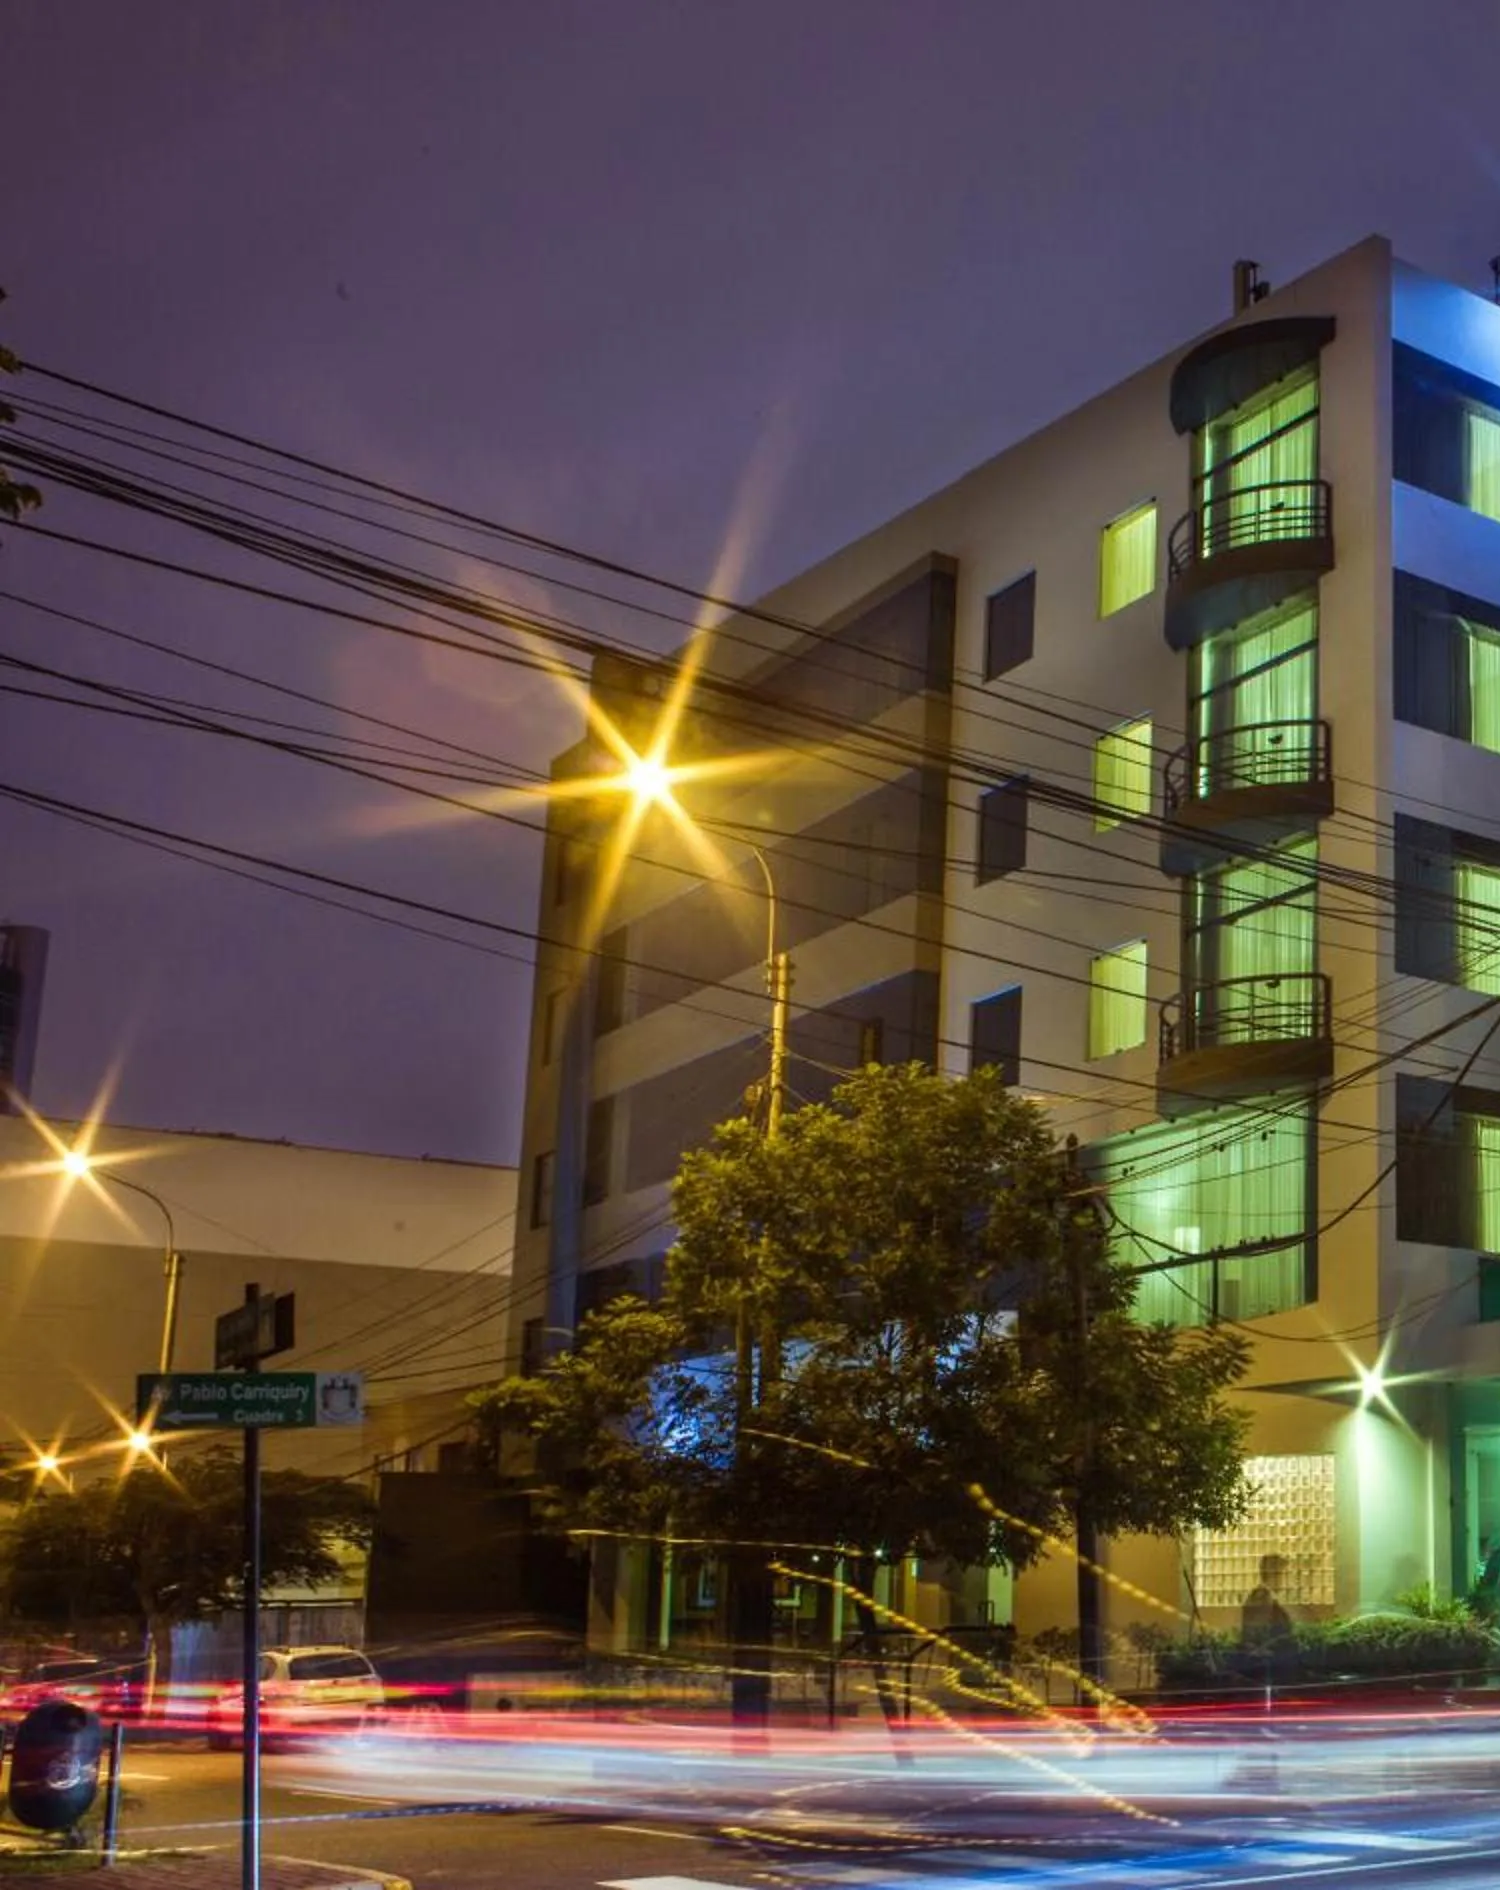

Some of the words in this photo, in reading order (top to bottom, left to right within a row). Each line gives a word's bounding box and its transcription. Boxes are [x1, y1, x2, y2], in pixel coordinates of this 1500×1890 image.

[180, 1383, 227, 1400] Pablo
[231, 1382, 310, 1404] Carriquiry
[233, 1408, 284, 1424] Cuadra
